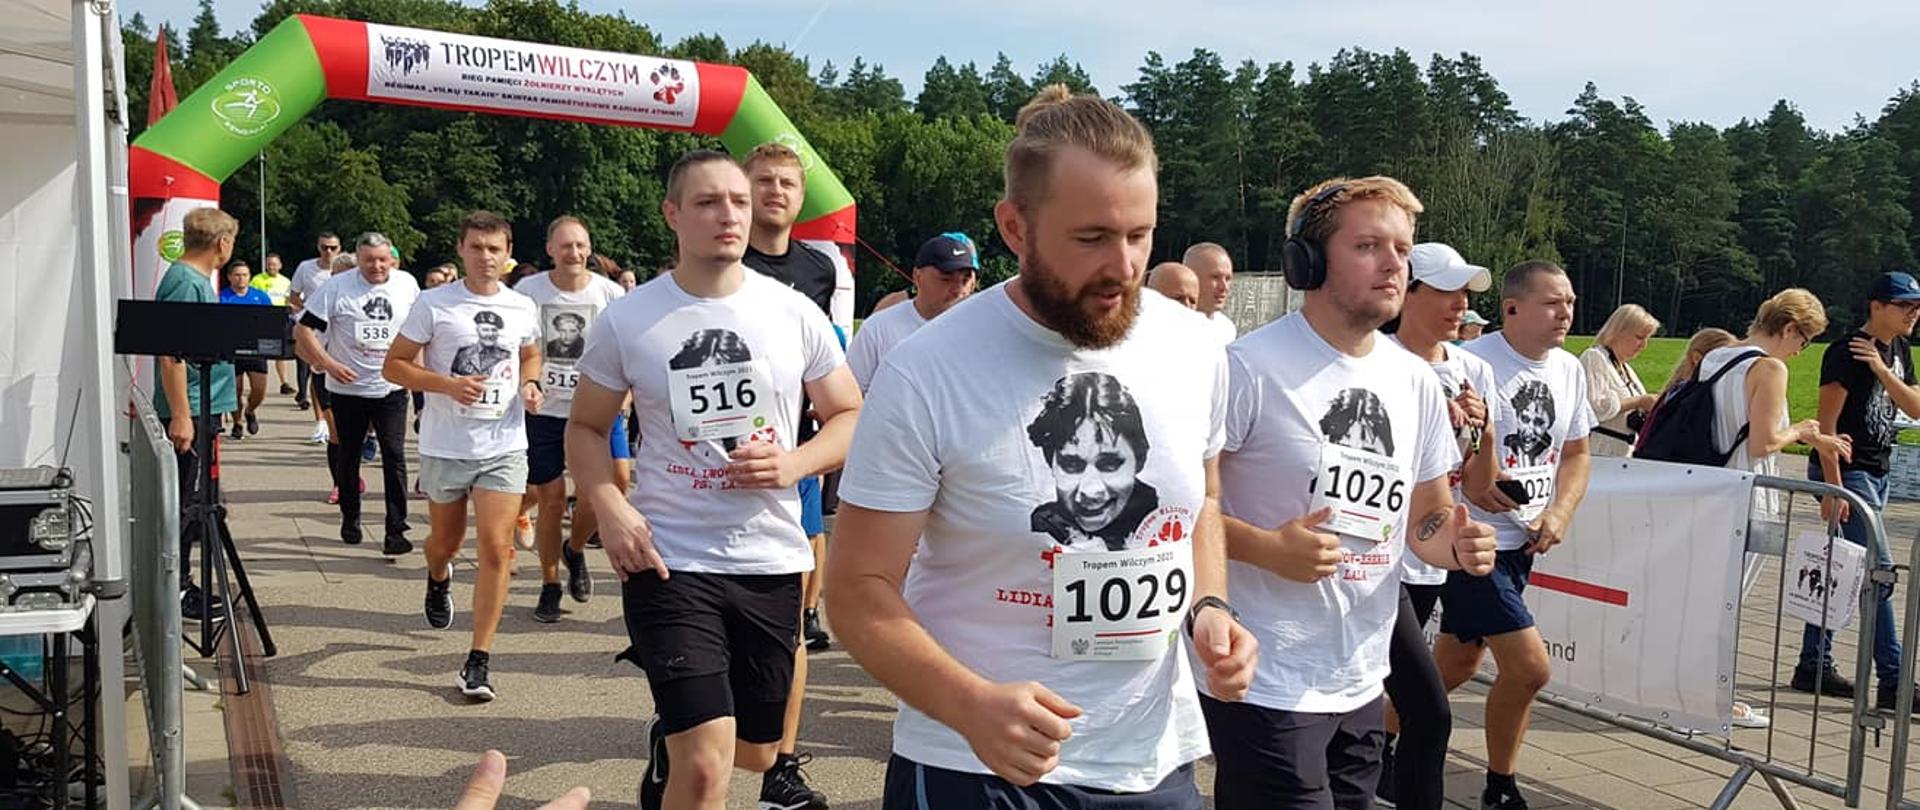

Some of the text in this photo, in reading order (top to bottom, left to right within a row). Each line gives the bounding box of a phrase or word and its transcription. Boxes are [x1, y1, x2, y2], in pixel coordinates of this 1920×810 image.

[224, 78, 271, 94] SPORTO
[363, 327, 389, 340] 538
[546, 371, 578, 389] 515
[478, 389, 501, 404] 11
[689, 378, 757, 415] 516
[1324, 465, 1405, 513] 1026
[1082, 560, 1118, 571] Tropem
[1120, 556, 1155, 567] Wilczym
[997, 589, 1054, 608] LIDIA
[1065, 567, 1187, 623] 1029
